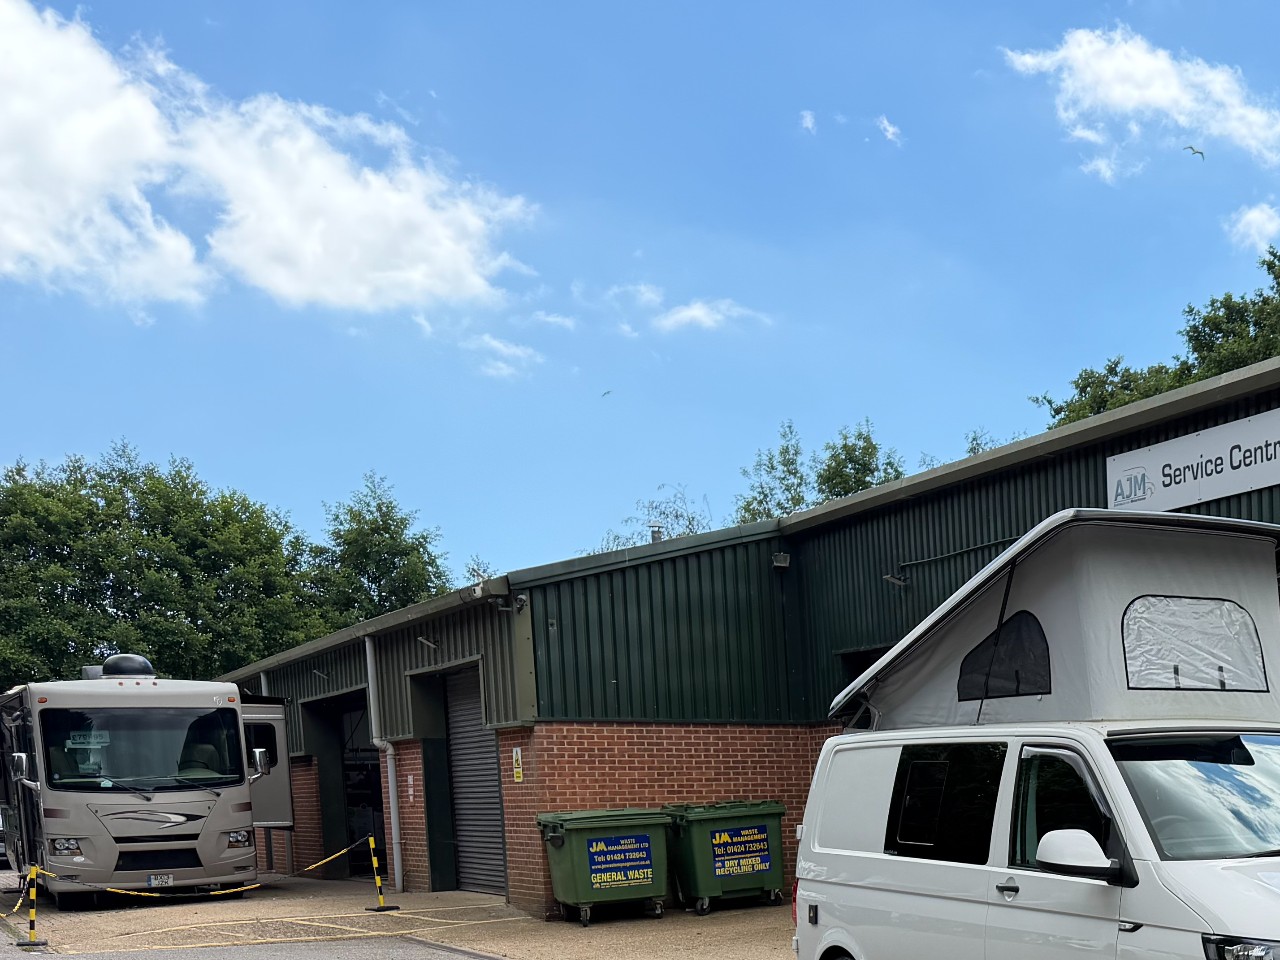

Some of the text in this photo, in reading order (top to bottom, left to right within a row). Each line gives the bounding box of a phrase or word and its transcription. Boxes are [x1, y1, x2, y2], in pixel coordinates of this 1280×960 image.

[1162, 454, 1224, 488] Service
[1114, 472, 1146, 502] AJM
[712, 832, 732, 845] JM
[589, 840, 608, 853] JM
[727, 845, 744, 853] 01424
[607, 853, 624, 861] 01424
[591, 868, 653, 883] GENERAL WASTE
